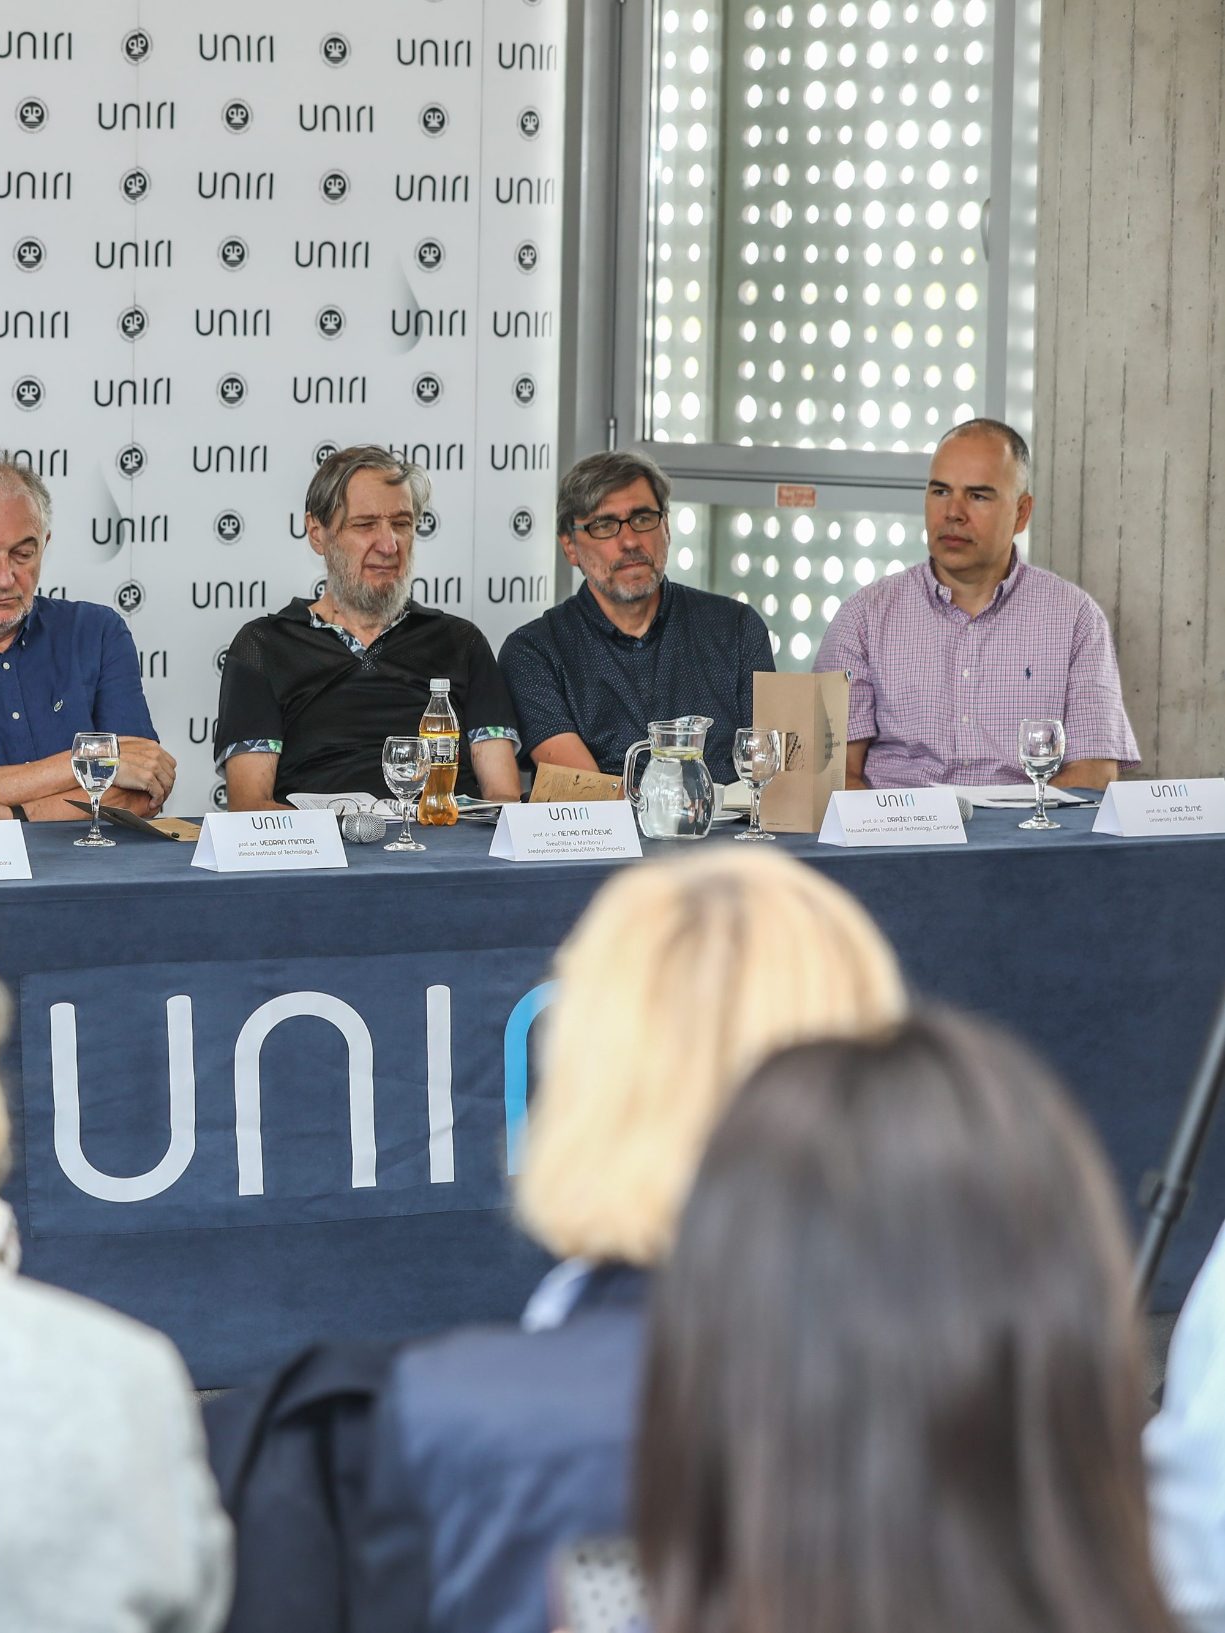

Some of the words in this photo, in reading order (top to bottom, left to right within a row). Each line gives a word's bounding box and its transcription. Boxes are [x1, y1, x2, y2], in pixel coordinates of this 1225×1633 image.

[557, 829, 580, 837] NENAD
[259, 838, 287, 847] VEDRAN
[50, 978, 564, 1202] UNIR
